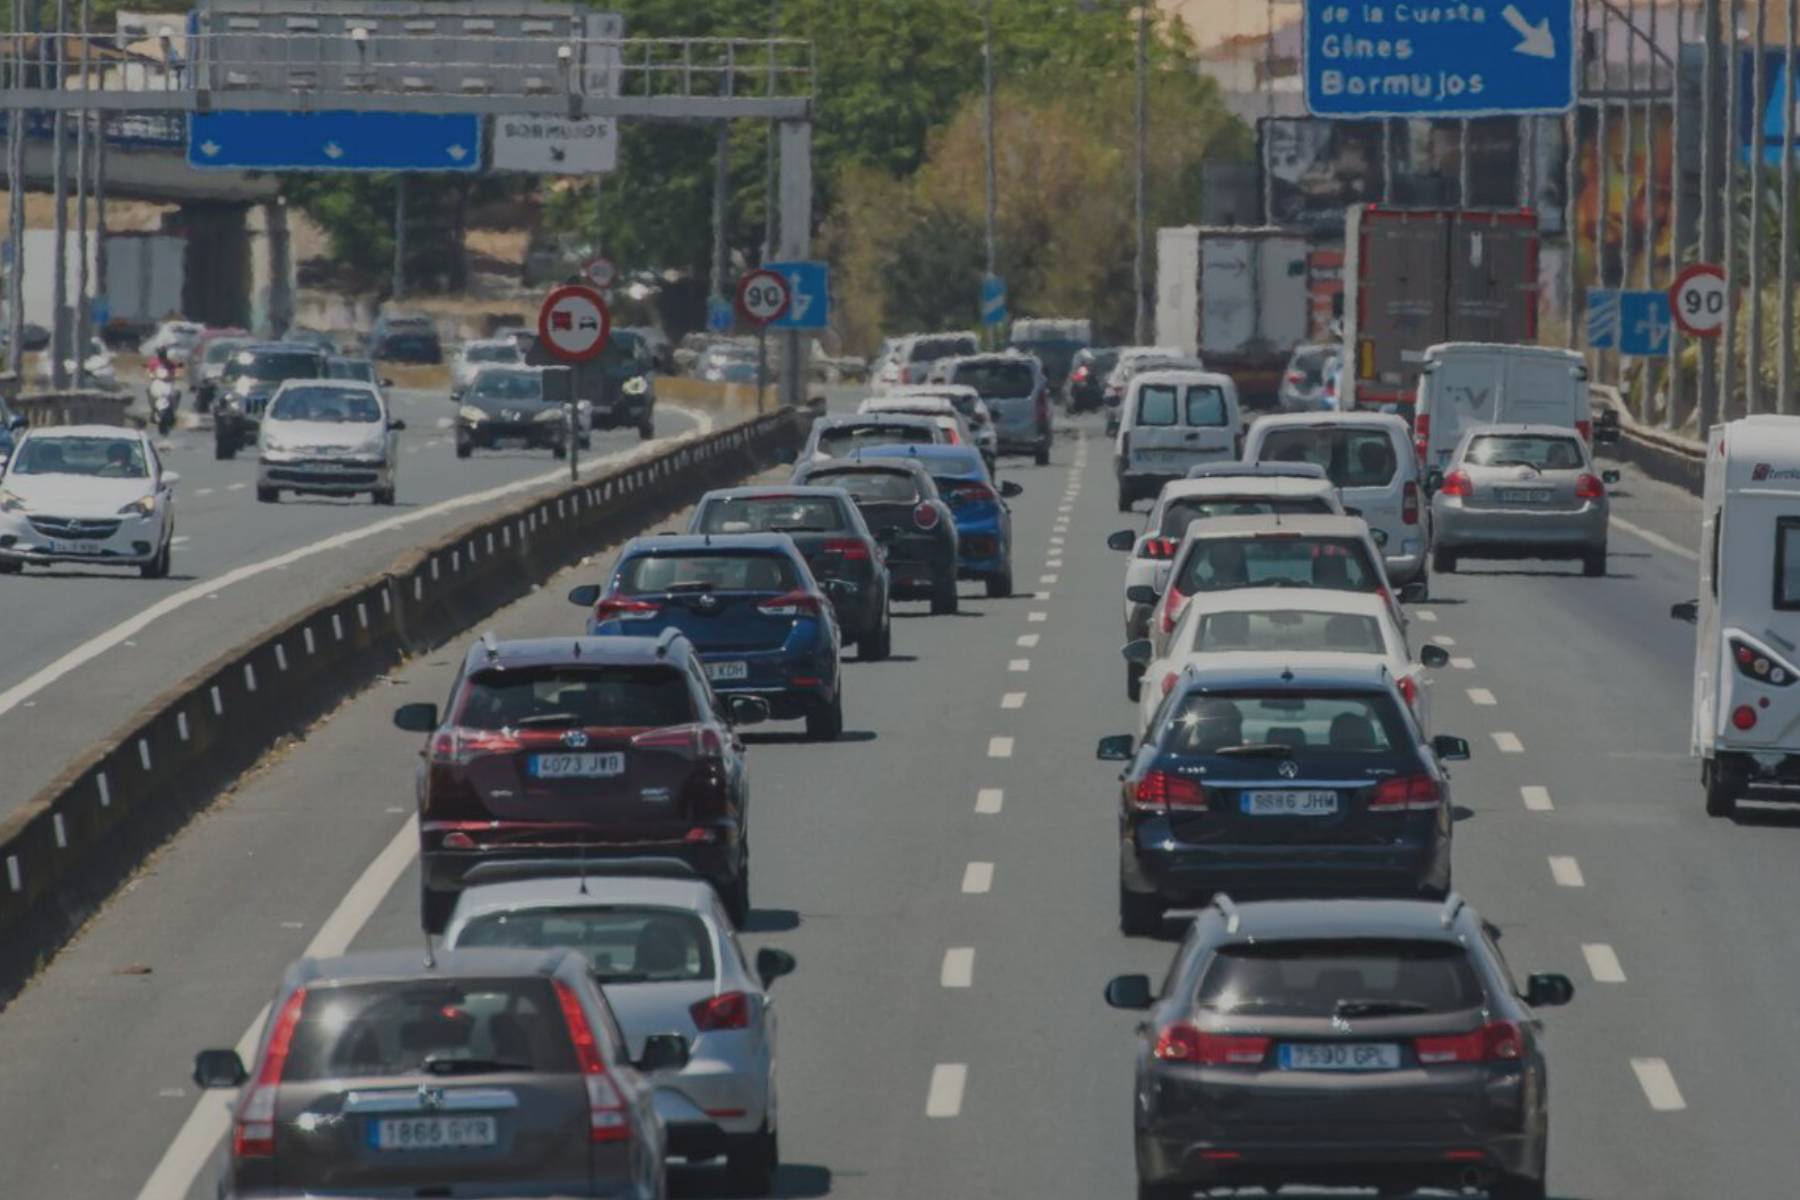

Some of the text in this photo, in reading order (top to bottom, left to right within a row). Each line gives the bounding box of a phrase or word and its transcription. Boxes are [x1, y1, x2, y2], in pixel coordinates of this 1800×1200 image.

[1322, 4, 1486, 23] de la Cuesta
[1322, 34, 1414, 59] Gines
[1321, 70, 1485, 101] Bormujos
[749, 286, 779, 307] 90
[1686, 288, 1723, 314] 90
[541, 754, 583, 772] 4073
